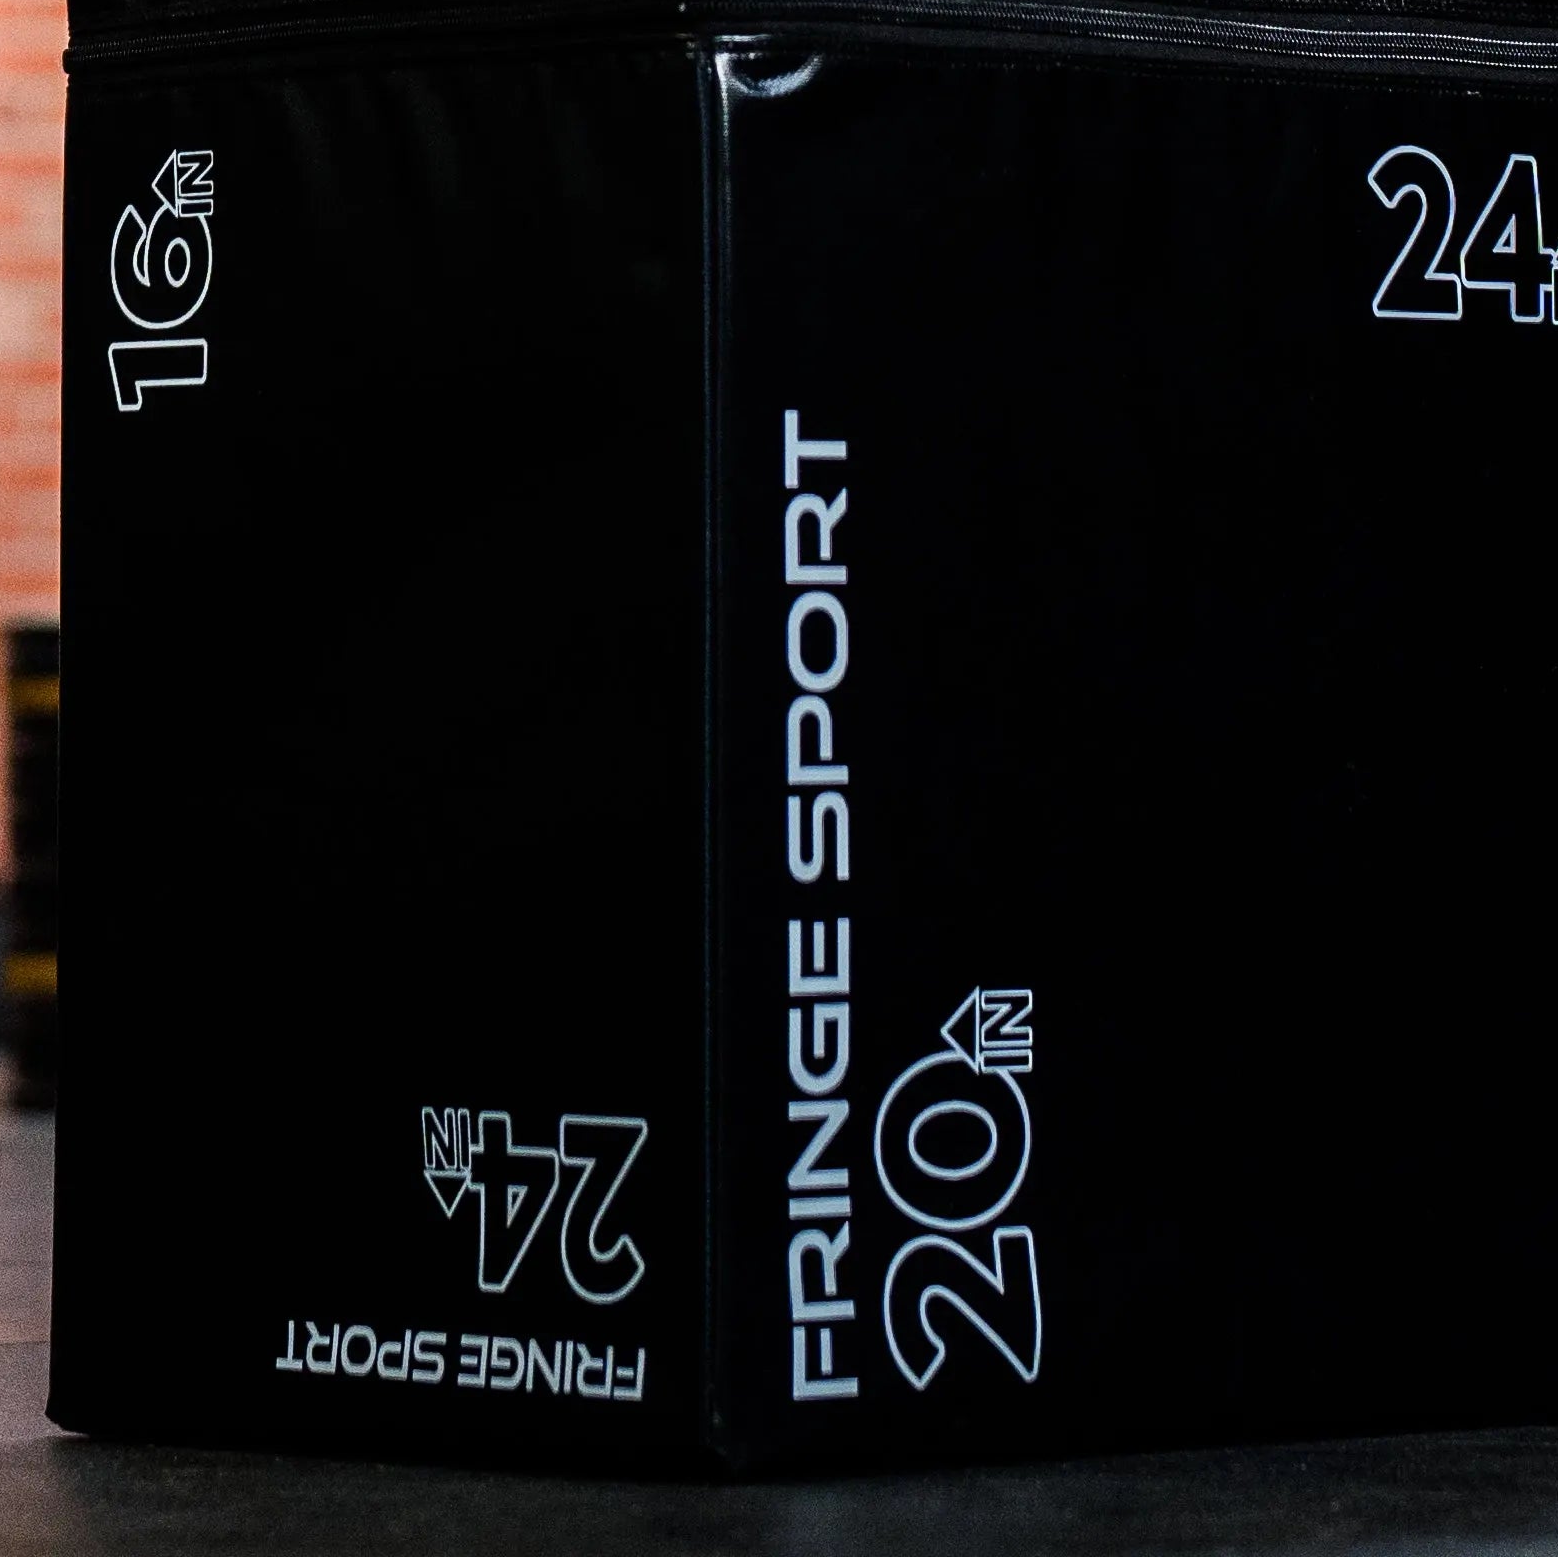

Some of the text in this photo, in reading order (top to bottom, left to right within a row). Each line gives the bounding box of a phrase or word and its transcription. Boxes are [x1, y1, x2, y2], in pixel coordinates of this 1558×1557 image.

[784, 409, 859, 1401] FRINGE SPORT
[275, 1320, 646, 1401] FRINGE SPORT
